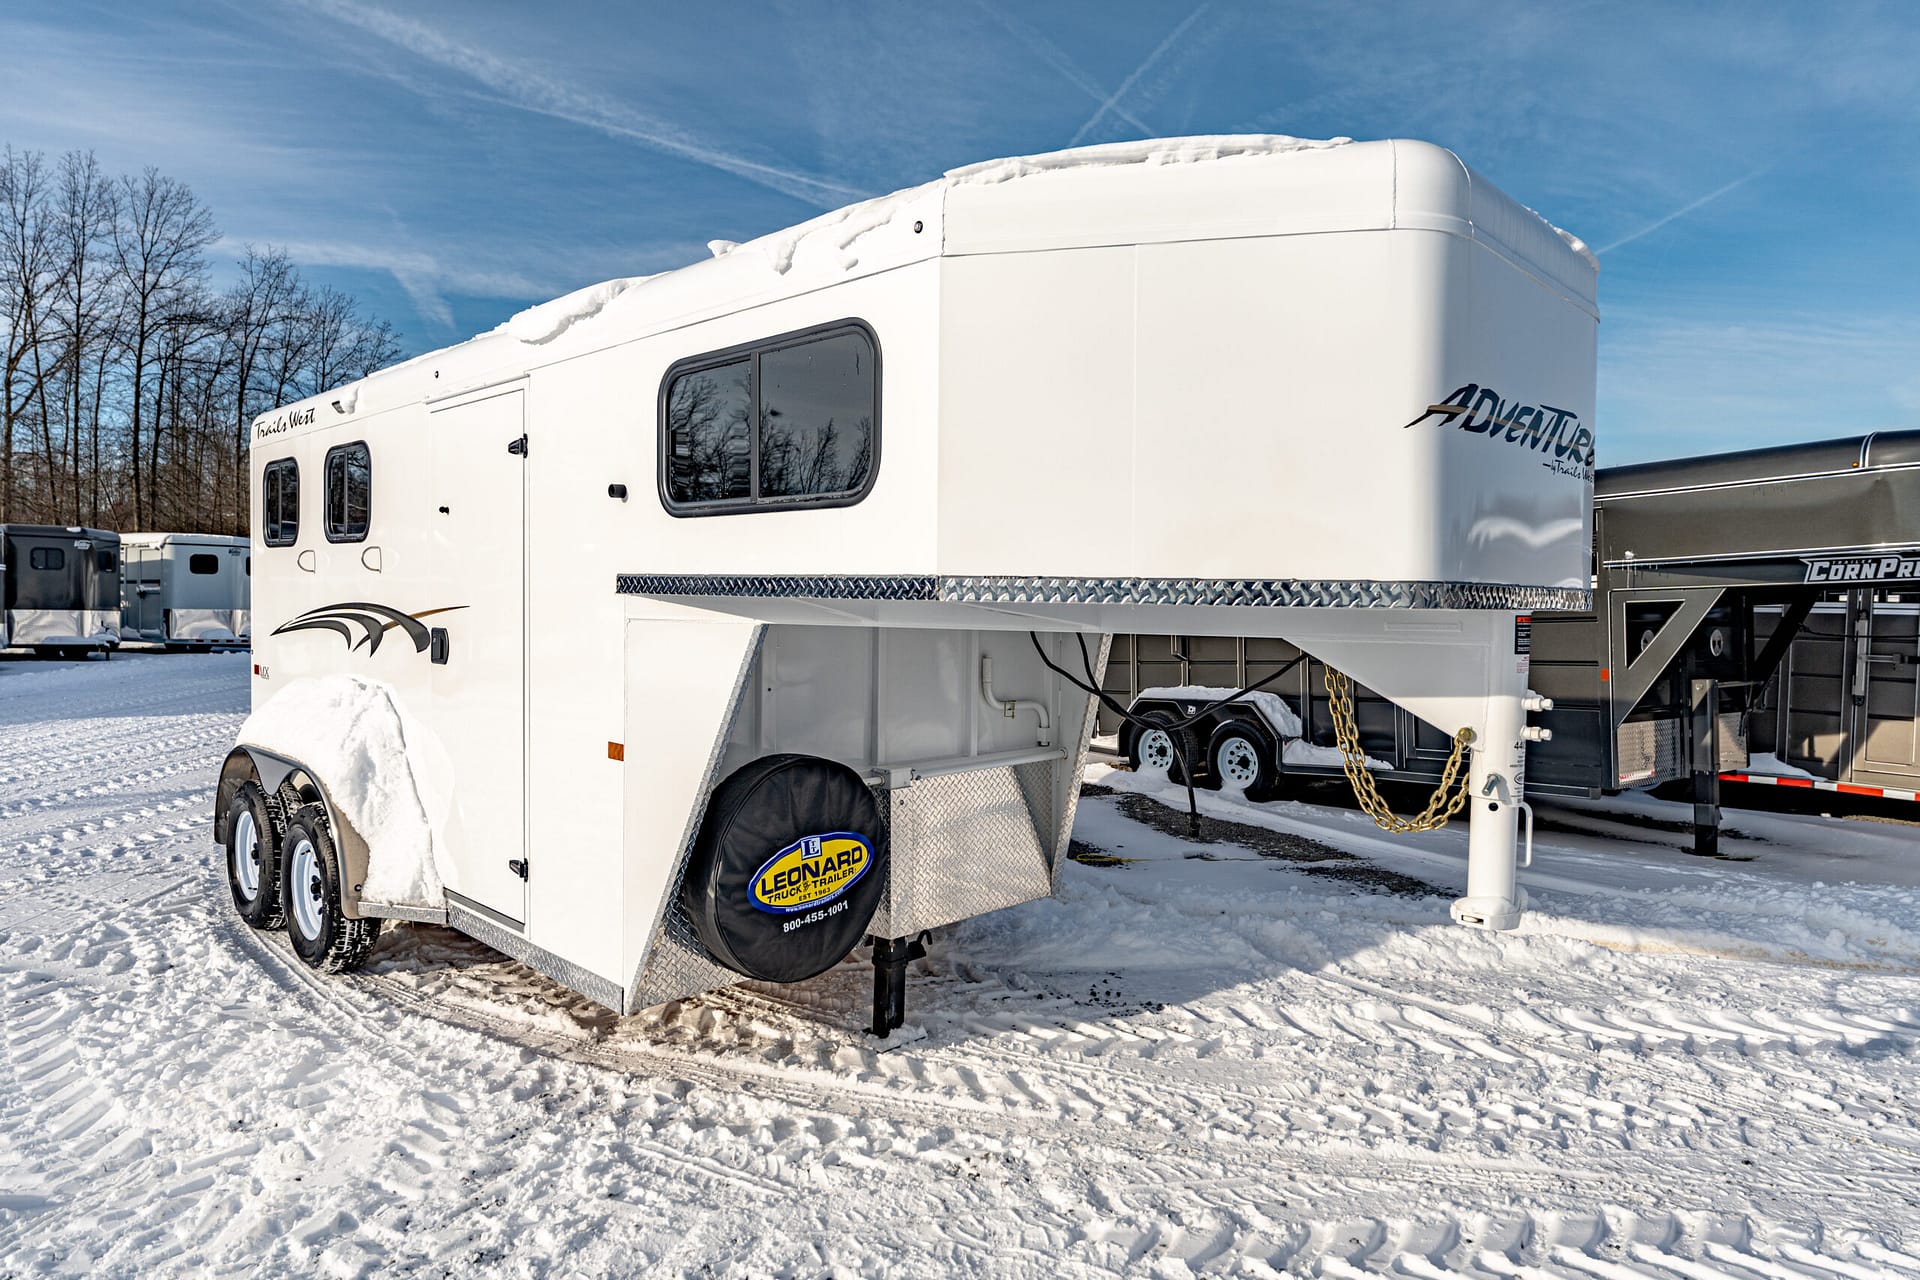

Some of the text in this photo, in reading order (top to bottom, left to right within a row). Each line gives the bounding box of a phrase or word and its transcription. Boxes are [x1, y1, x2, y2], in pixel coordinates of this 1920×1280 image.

[255, 408, 315, 440] Trails West
[1555, 460, 1581, 479] Trails
[1582, 464, 1595, 483] Wes
[761, 846, 863, 896] LEONARD
[767, 885, 802, 903] TRUCK
[812, 867, 855, 888] TRAILER
[814, 887, 831, 896] 1963
[783, 900, 849, 933] 800-455-1001
